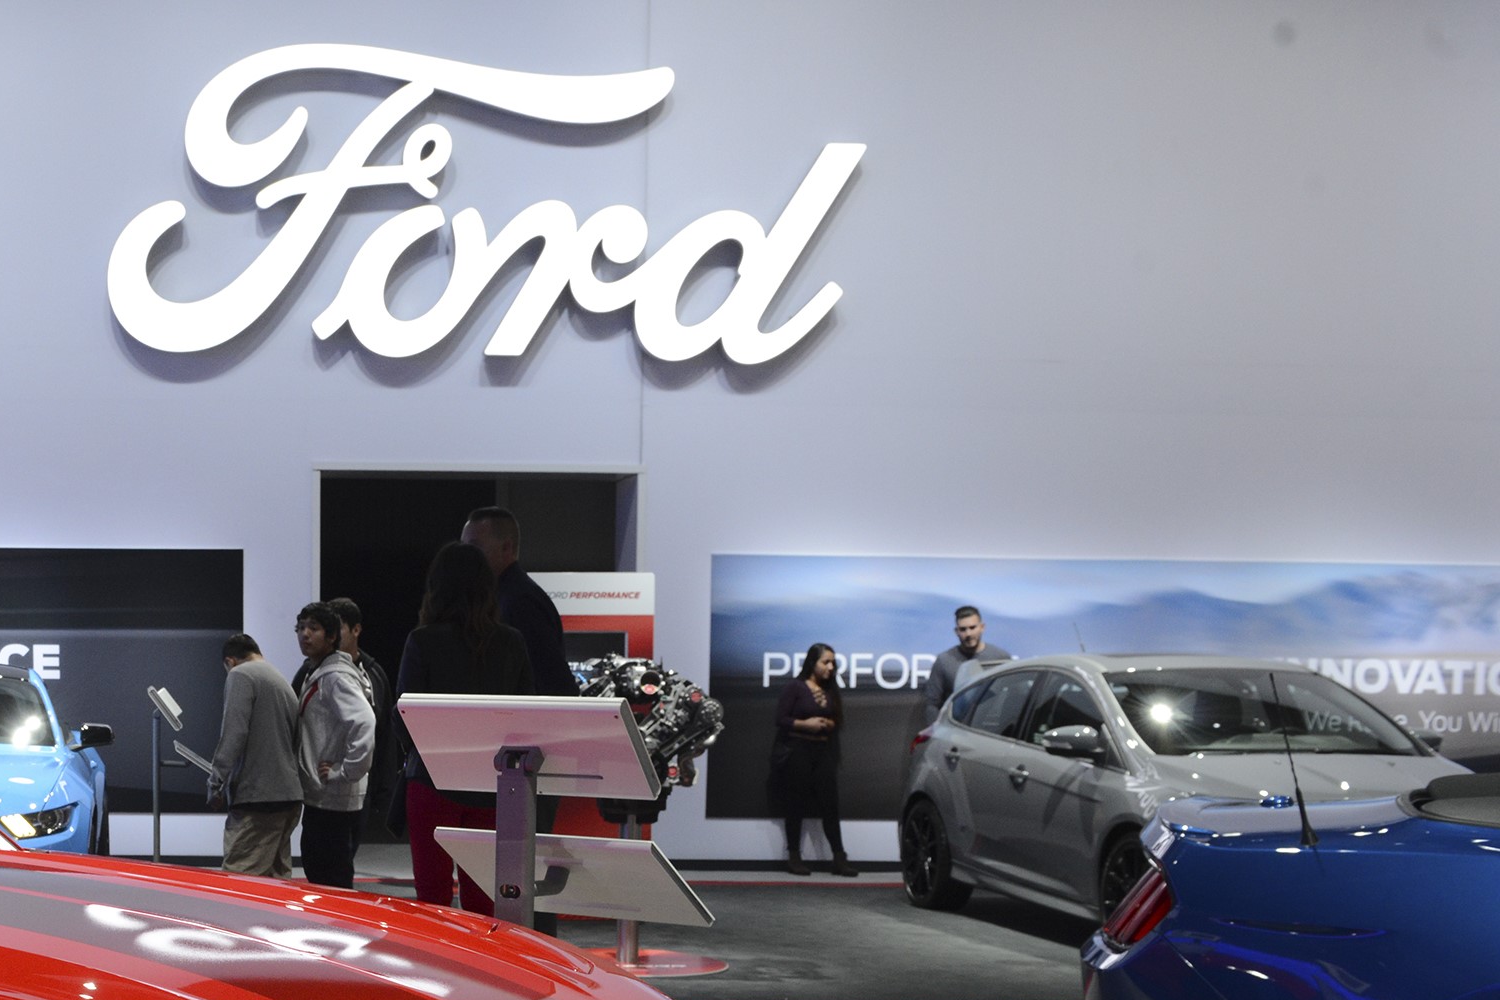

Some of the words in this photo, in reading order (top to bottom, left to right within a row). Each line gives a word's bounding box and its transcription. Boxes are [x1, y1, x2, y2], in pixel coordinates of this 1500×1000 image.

[107, 43, 867, 365] Ford
[569, 591, 641, 599] PERFORMANCE
[1418, 710, 1462, 733] You
